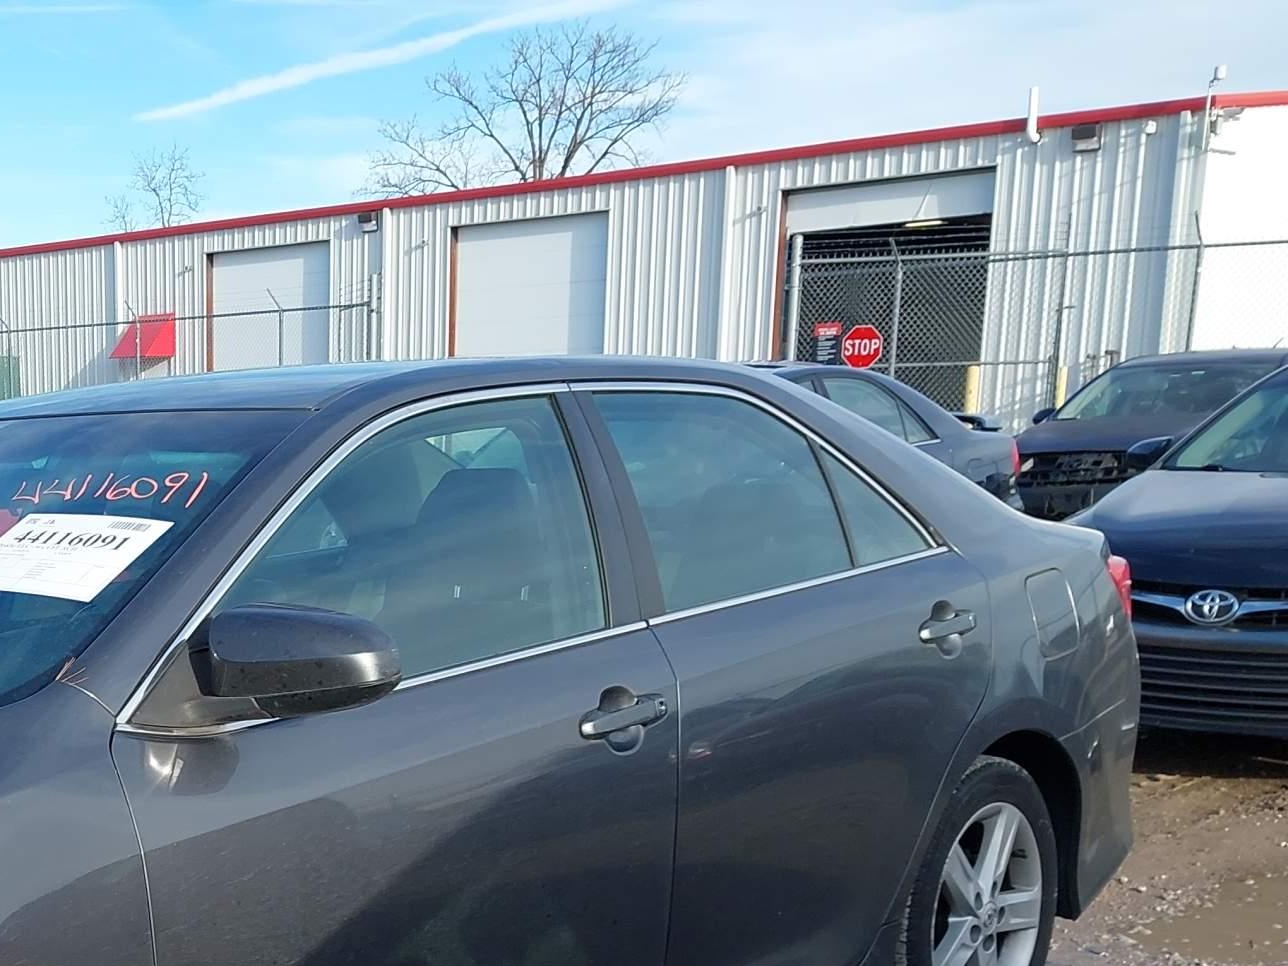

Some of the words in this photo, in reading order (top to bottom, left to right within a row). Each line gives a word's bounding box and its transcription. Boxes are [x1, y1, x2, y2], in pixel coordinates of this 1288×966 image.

[844, 338, 880, 357] STOP
[11, 472, 208, 509] 44116091
[13, 529, 131, 551] 44116091
